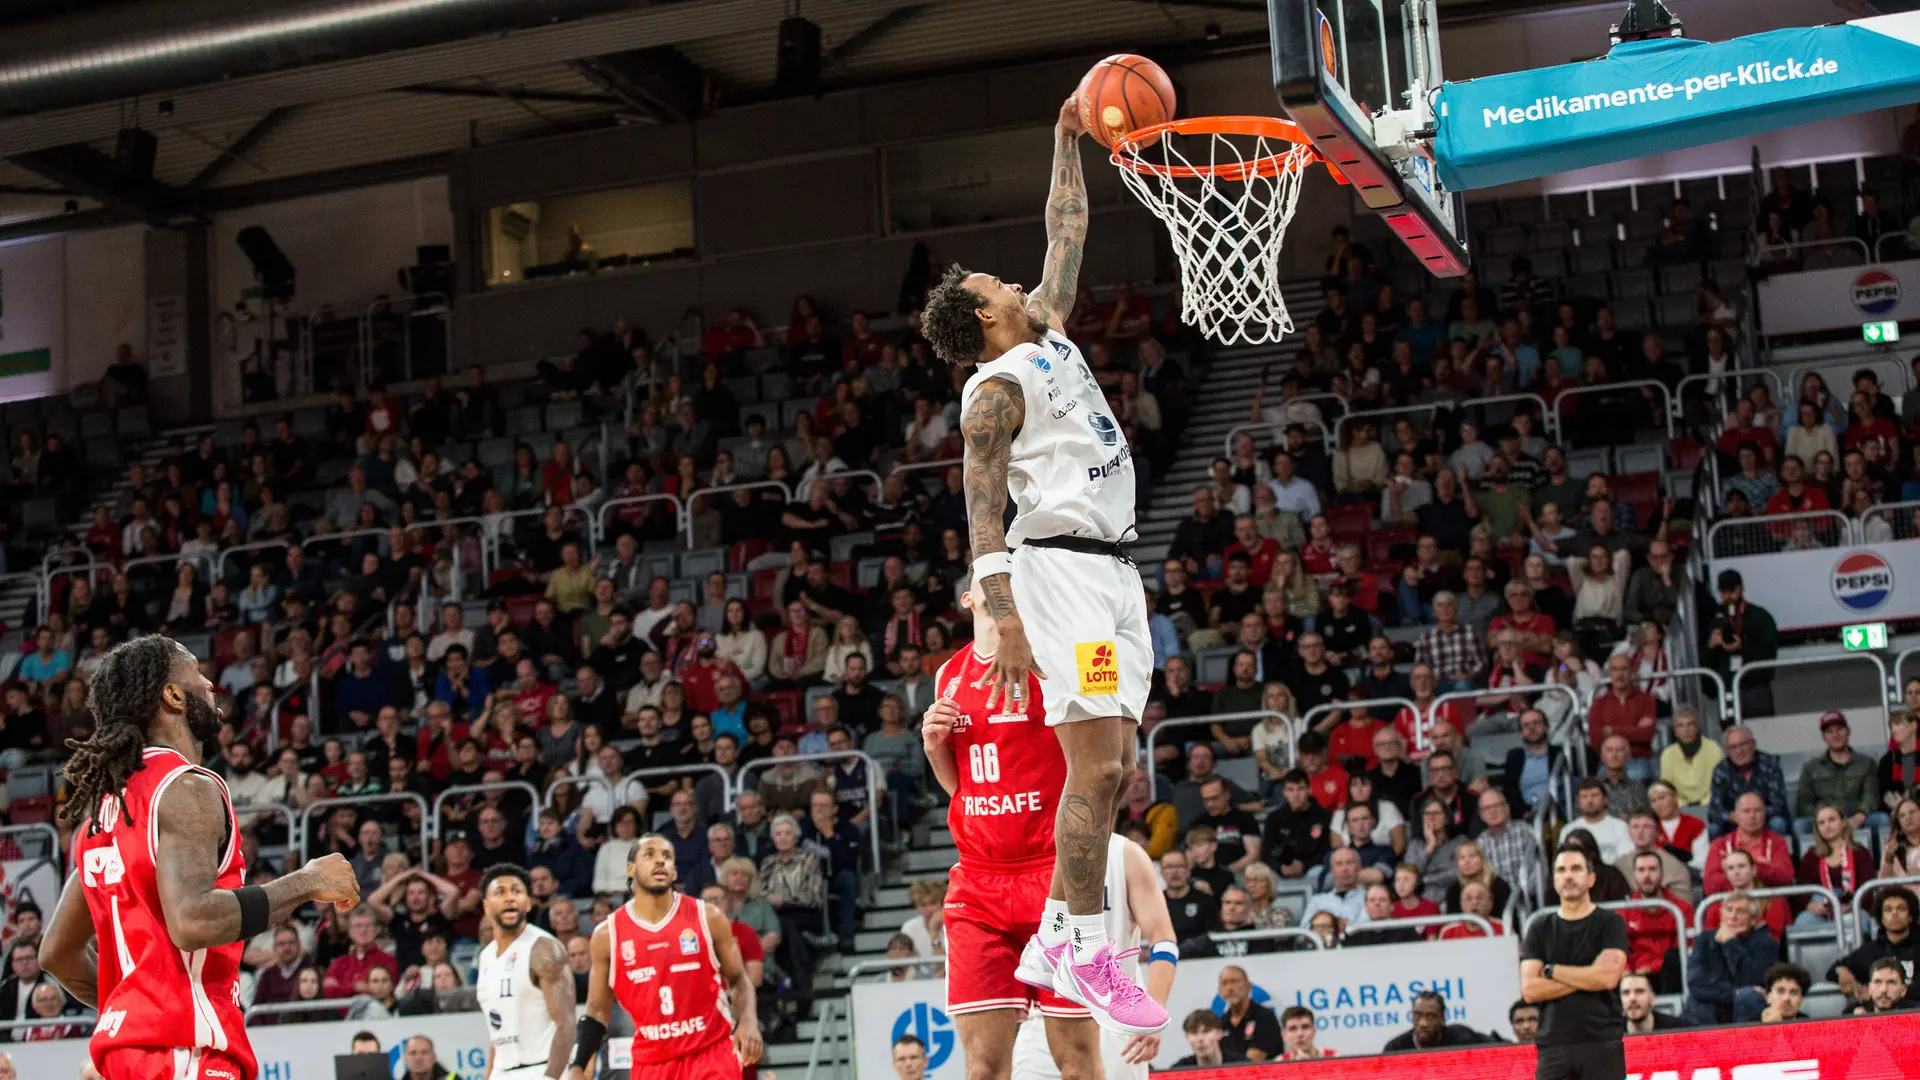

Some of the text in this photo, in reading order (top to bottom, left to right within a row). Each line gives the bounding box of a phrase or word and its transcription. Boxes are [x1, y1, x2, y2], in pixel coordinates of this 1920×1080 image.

[1482, 58, 1839, 128] Medikamente-per-Klick.de
[1855, 284, 1897, 300] PEPSI
[1836, 573, 1889, 590] PEPSI
[1086, 670, 1118, 683] LOTTO
[969, 742, 1000, 784] 66
[961, 791, 1042, 816] RIOSAFE
[658, 985, 675, 1016] 3
[1296, 977, 1466, 1011] IGARASHI
[1312, 1011, 1399, 1031] OTOREN
